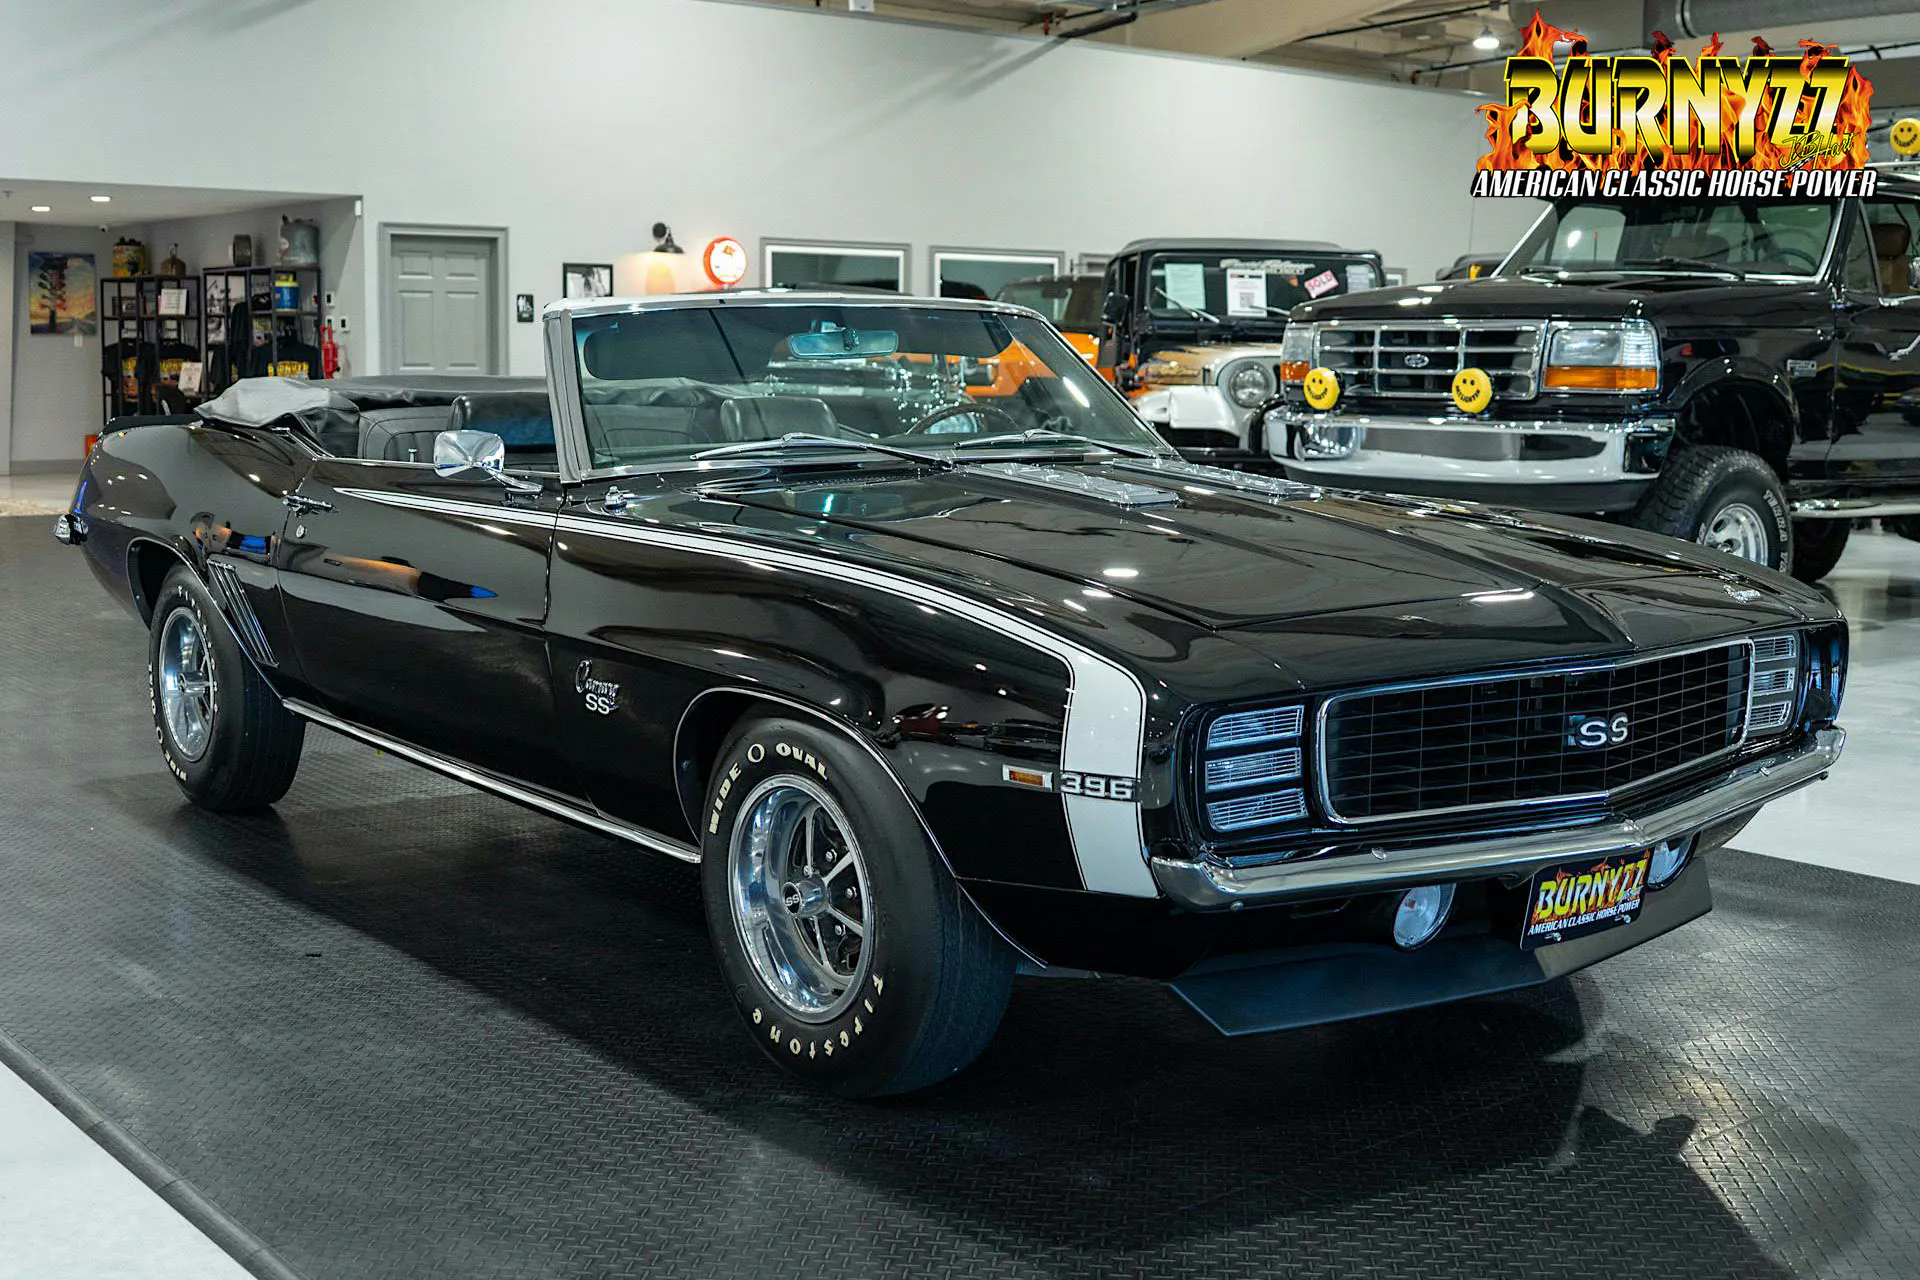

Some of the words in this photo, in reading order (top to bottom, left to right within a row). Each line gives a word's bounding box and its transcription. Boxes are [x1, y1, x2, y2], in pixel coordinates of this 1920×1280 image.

[1306, 271, 1334, 291] SOLD
[585, 692, 610, 715] SS
[1579, 715, 1629, 747] SS
[708, 762, 742, 835] WIDE
[775, 742, 828, 781] OVAL
[1060, 771, 1133, 800] 396
[785, 893, 800, 907] SS
[1536, 859, 1647, 919] BURNYZZ
[1528, 919, 1569, 936] AMERICAN
[1568, 911, 1597, 928] CLASSIC
[1596, 905, 1618, 920] HORSE
[1616, 898, 1641, 914] POWER
